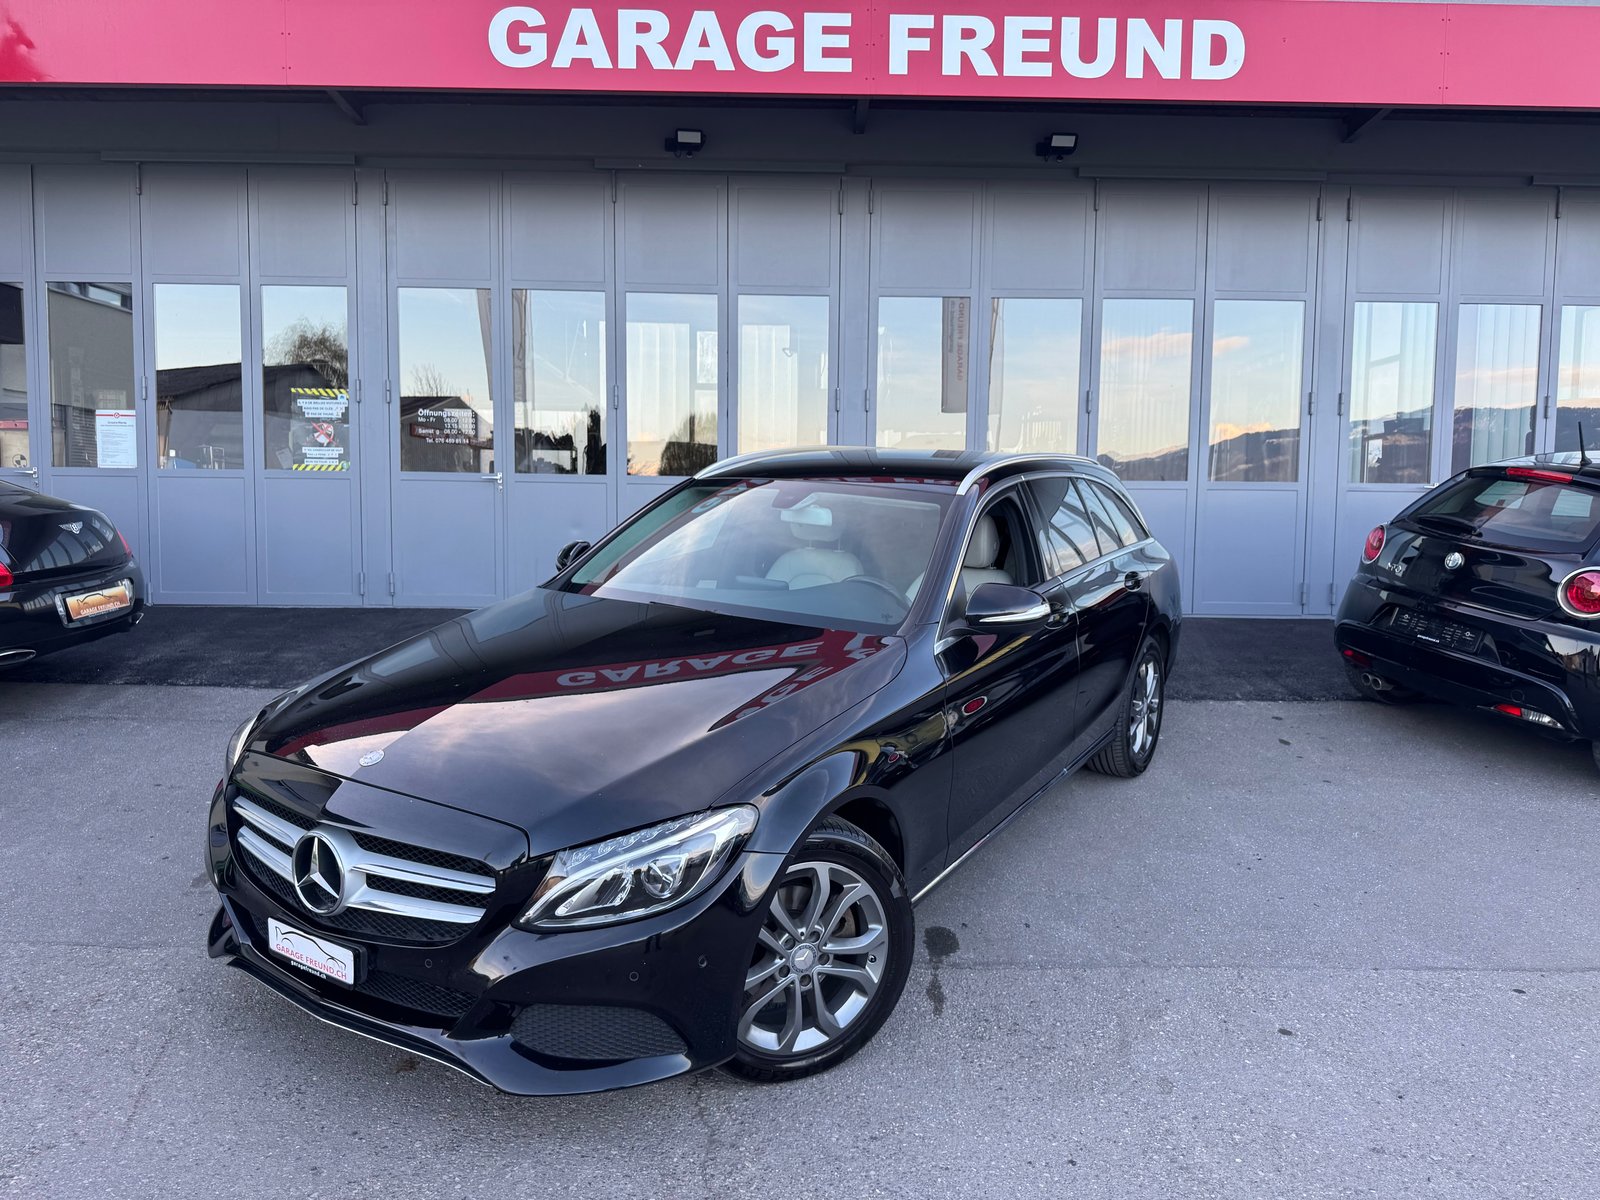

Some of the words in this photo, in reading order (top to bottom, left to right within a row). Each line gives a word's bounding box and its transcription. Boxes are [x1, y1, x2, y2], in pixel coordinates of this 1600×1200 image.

[488, 6, 853, 72] GARAGE
[888, 14, 1246, 80] FREUND
[276, 944, 304, 961] GARAGE
[306, 957, 347, 980] FREUND.CH
[291, 960, 327, 980] garagefreund.ch
